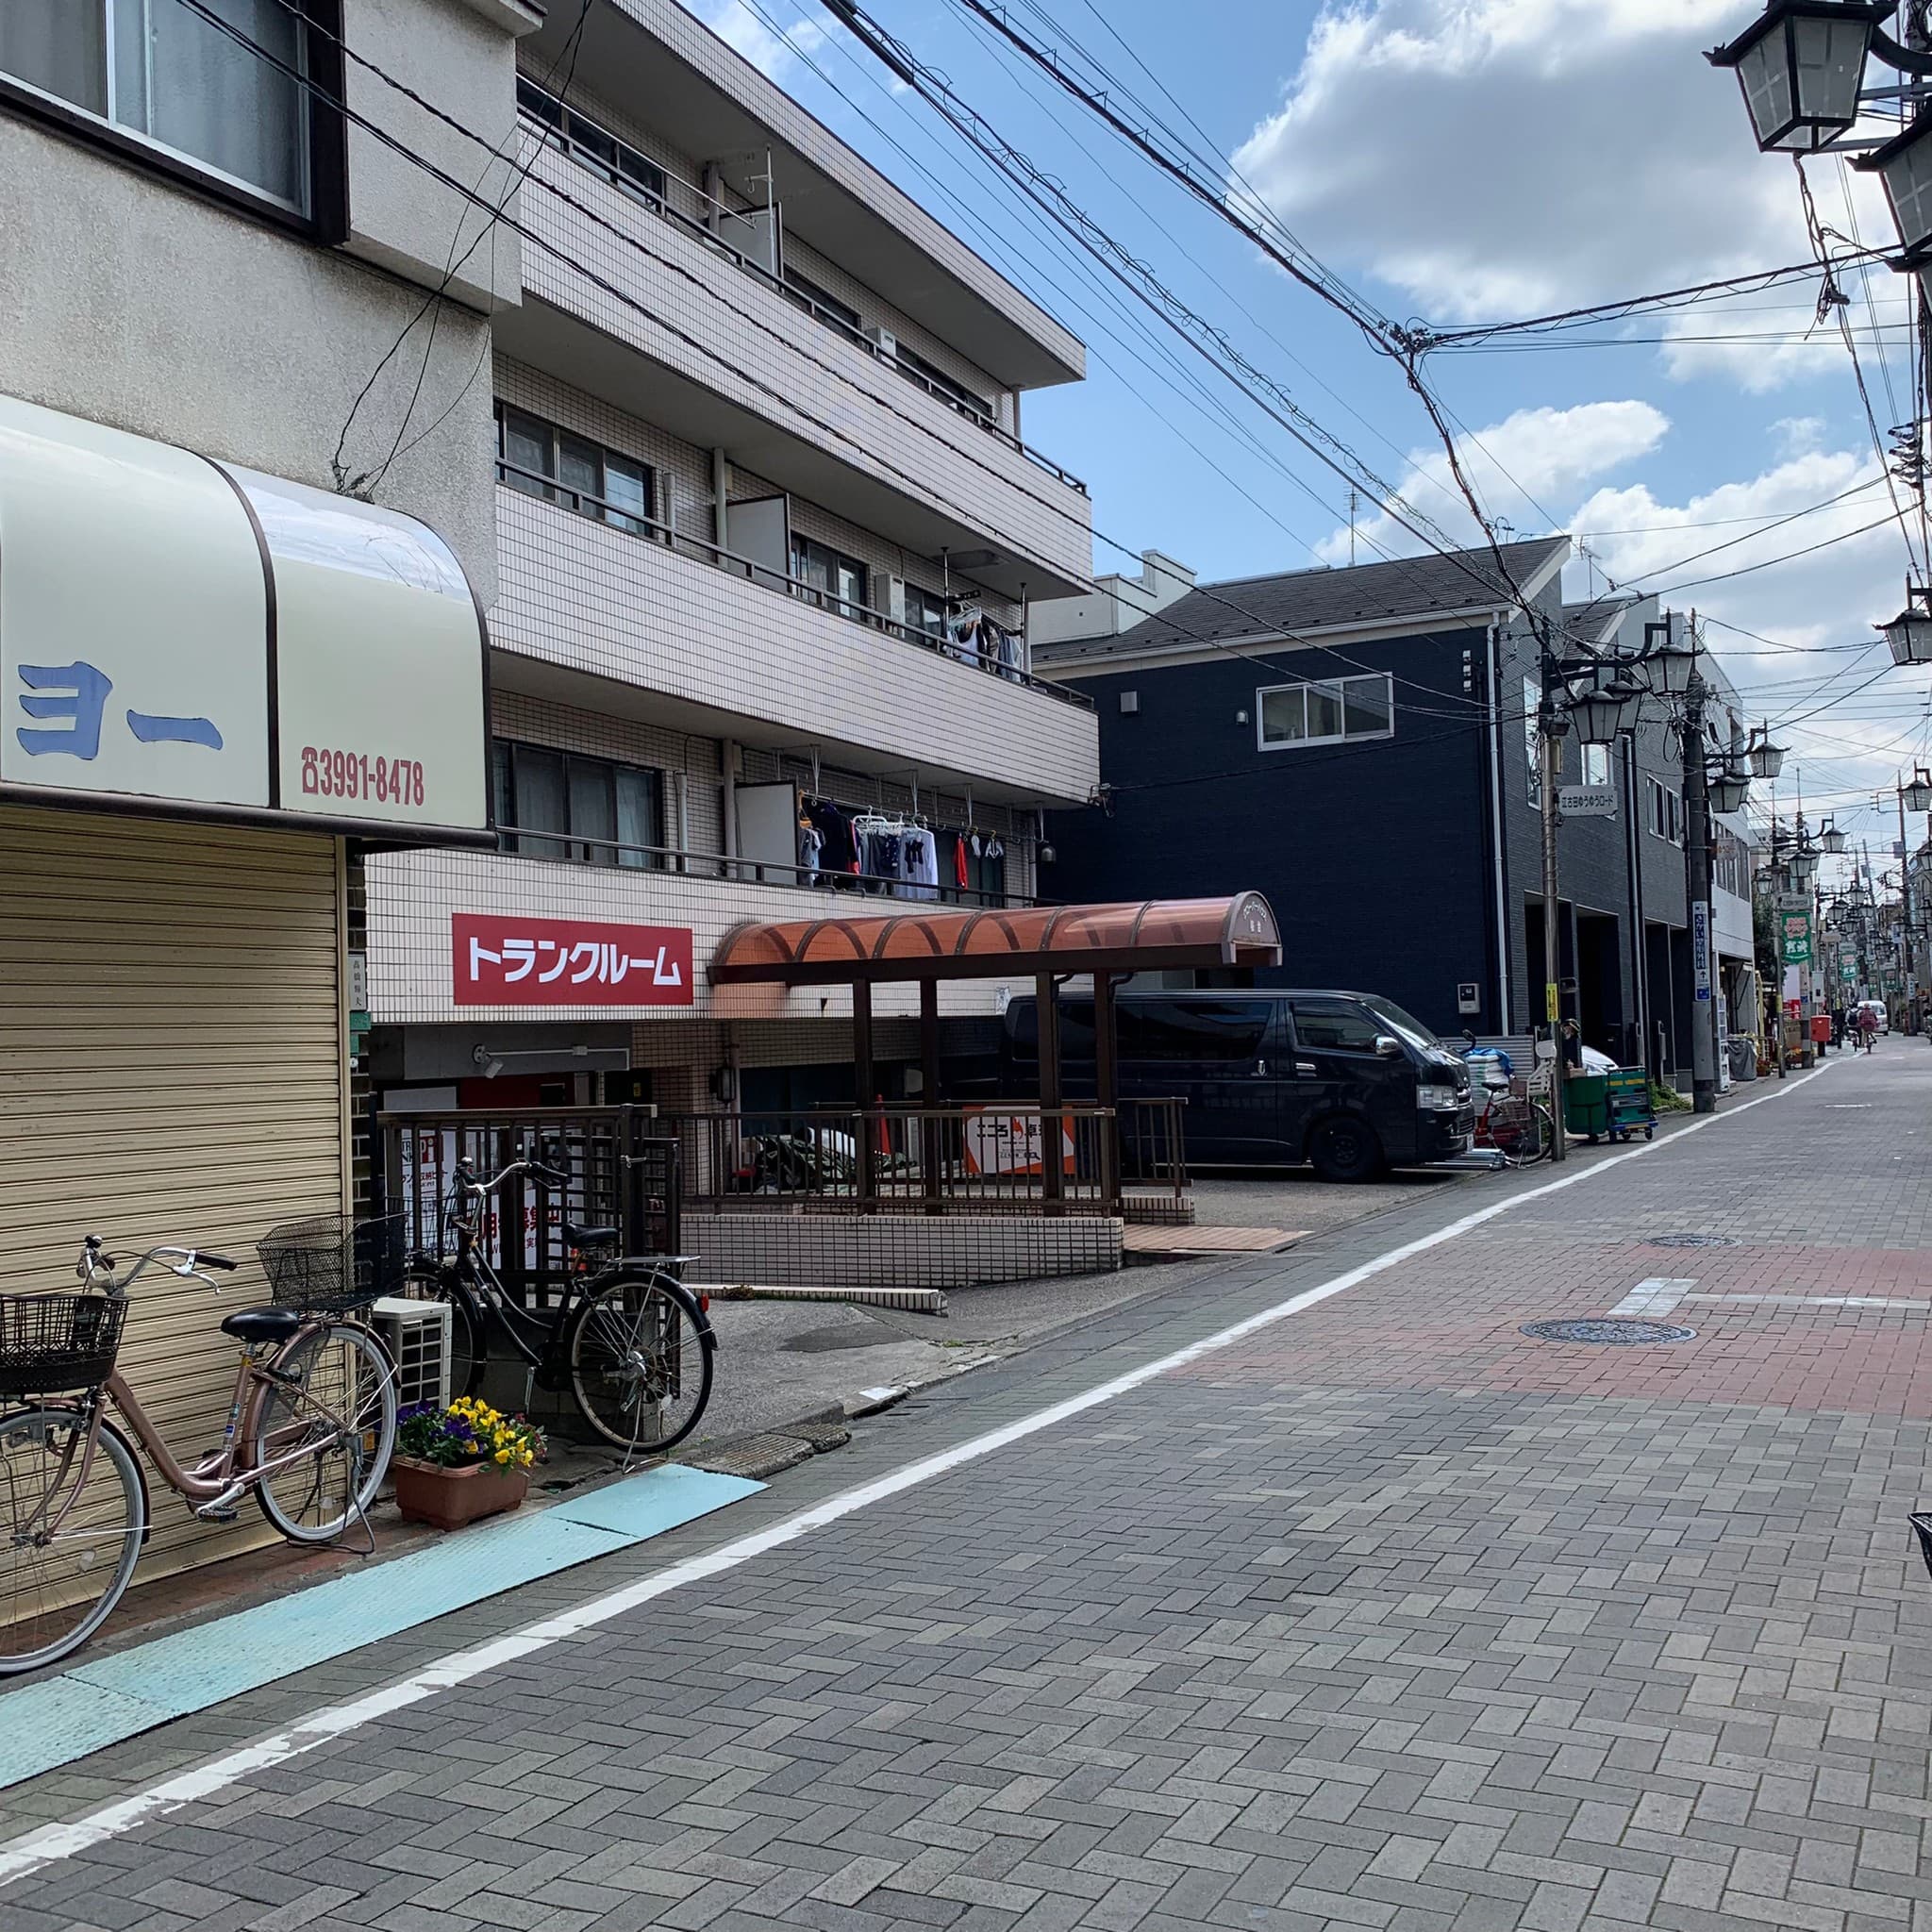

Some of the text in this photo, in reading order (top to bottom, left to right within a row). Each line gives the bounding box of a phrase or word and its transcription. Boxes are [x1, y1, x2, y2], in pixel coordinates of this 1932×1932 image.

[319, 748, 425, 806] 3991-8478
[470, 937, 682, 986] トランクルーム
